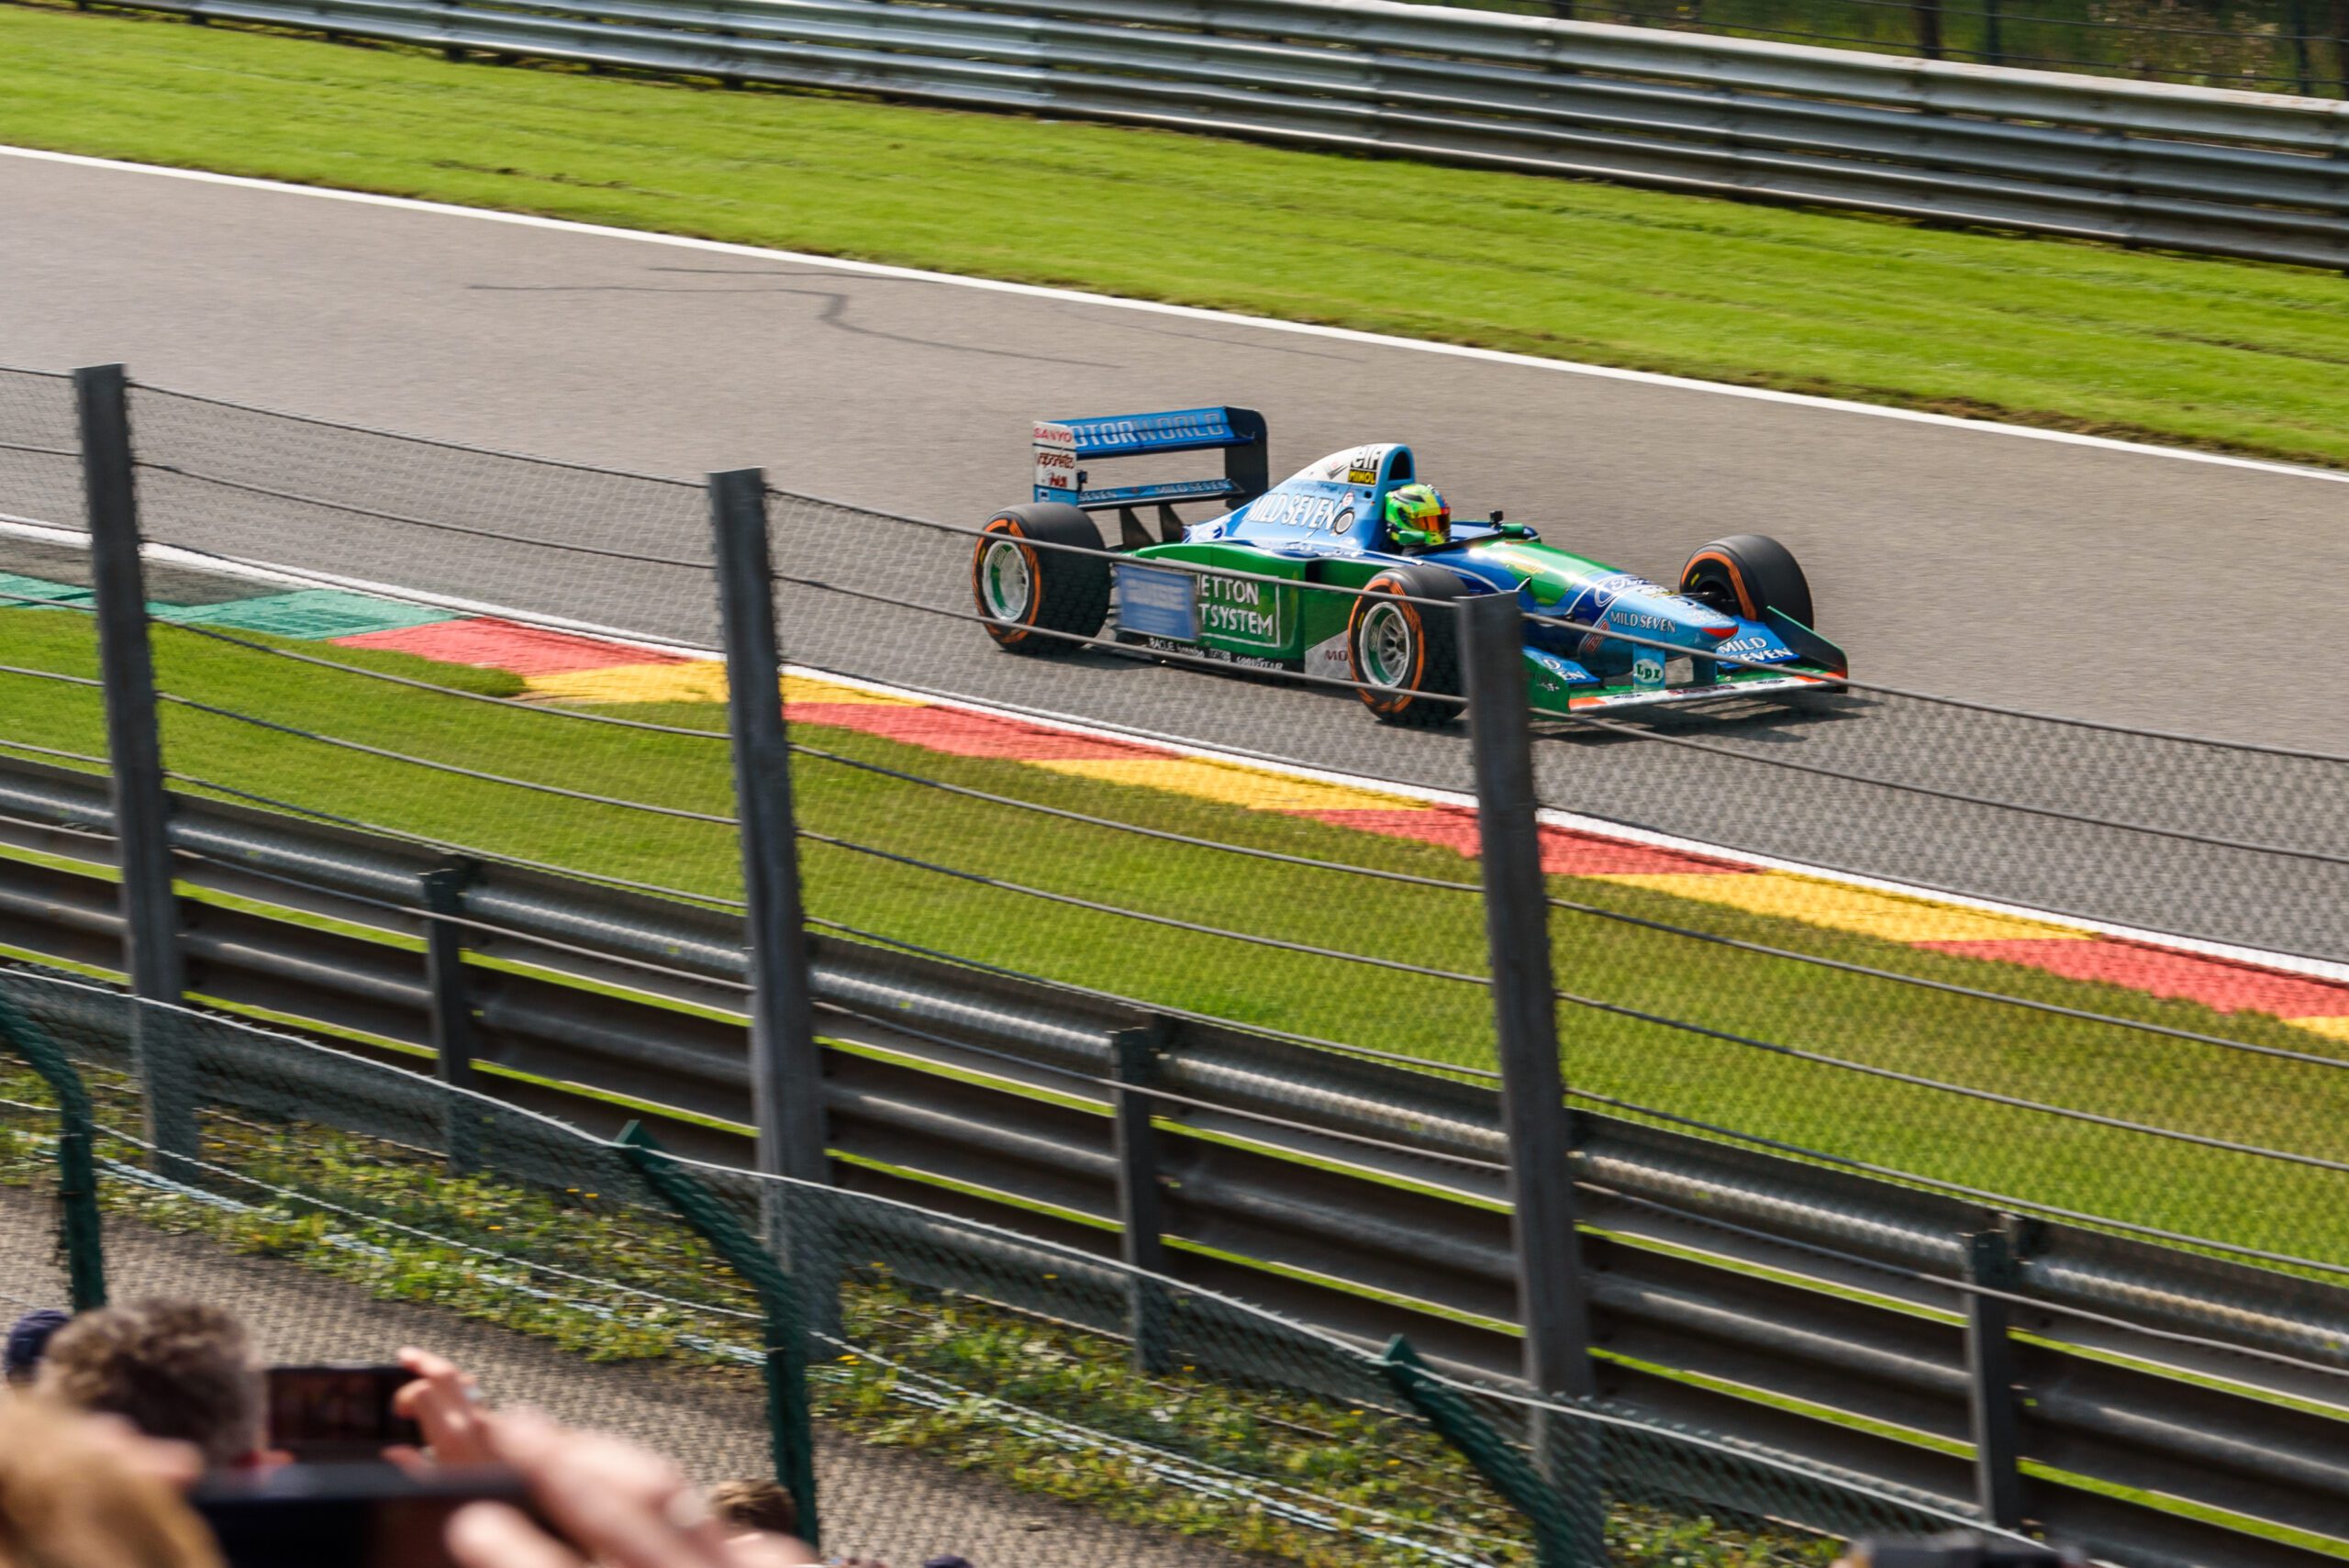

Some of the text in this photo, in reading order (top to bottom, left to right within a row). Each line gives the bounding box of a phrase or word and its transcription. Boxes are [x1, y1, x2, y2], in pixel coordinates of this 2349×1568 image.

[1032, 427, 1073, 443] SANYO
[1072, 413, 1225, 448] OTORWORLD
[1242, 492, 1291, 524] MILD
[1282, 495, 1343, 531] SEVEN
[1609, 609, 1639, 628] MILD
[1639, 614, 1677, 634] SEVEN
[1717, 636, 1768, 655] MILD
